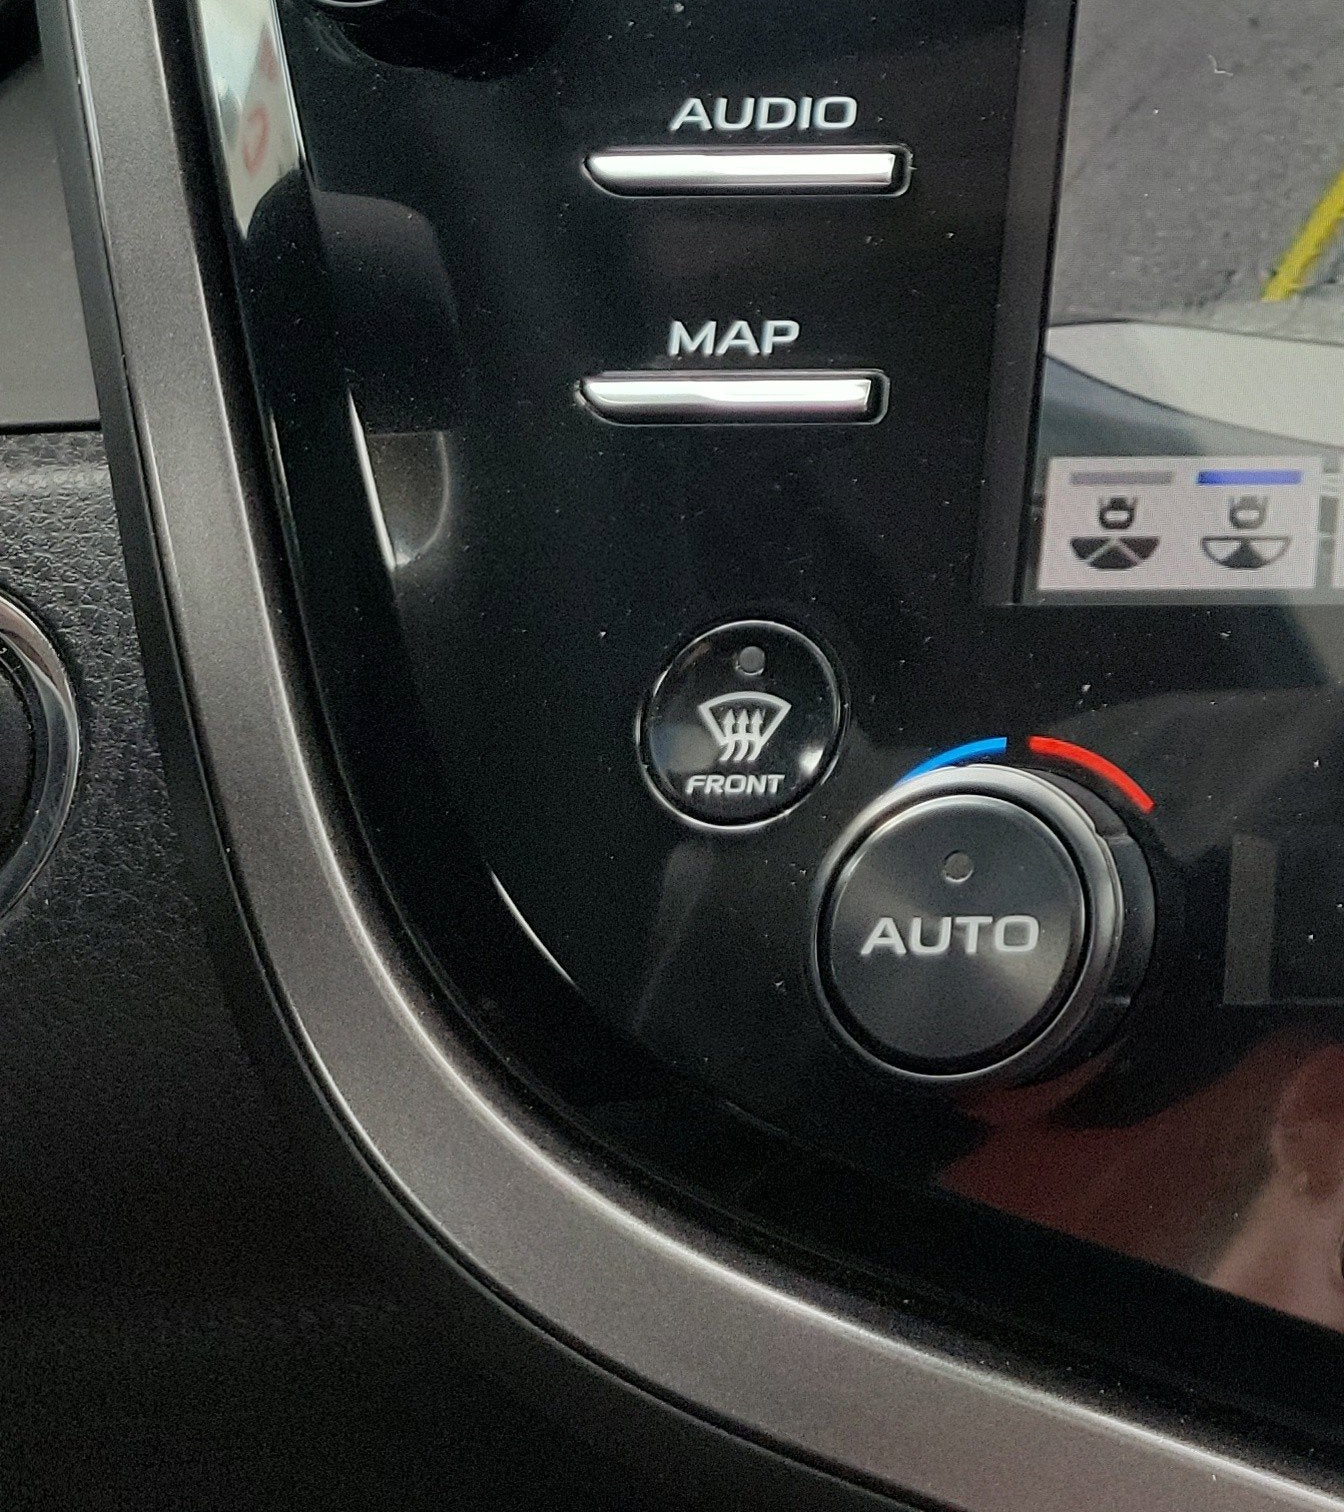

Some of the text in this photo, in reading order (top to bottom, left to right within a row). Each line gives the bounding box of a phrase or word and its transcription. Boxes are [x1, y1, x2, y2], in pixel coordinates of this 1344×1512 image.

[669, 96, 858, 131] AUDIO
[667, 320, 800, 356] MAP
[685, 774, 784, 795] FRONT
[860, 915, 1040, 956] AUTO
